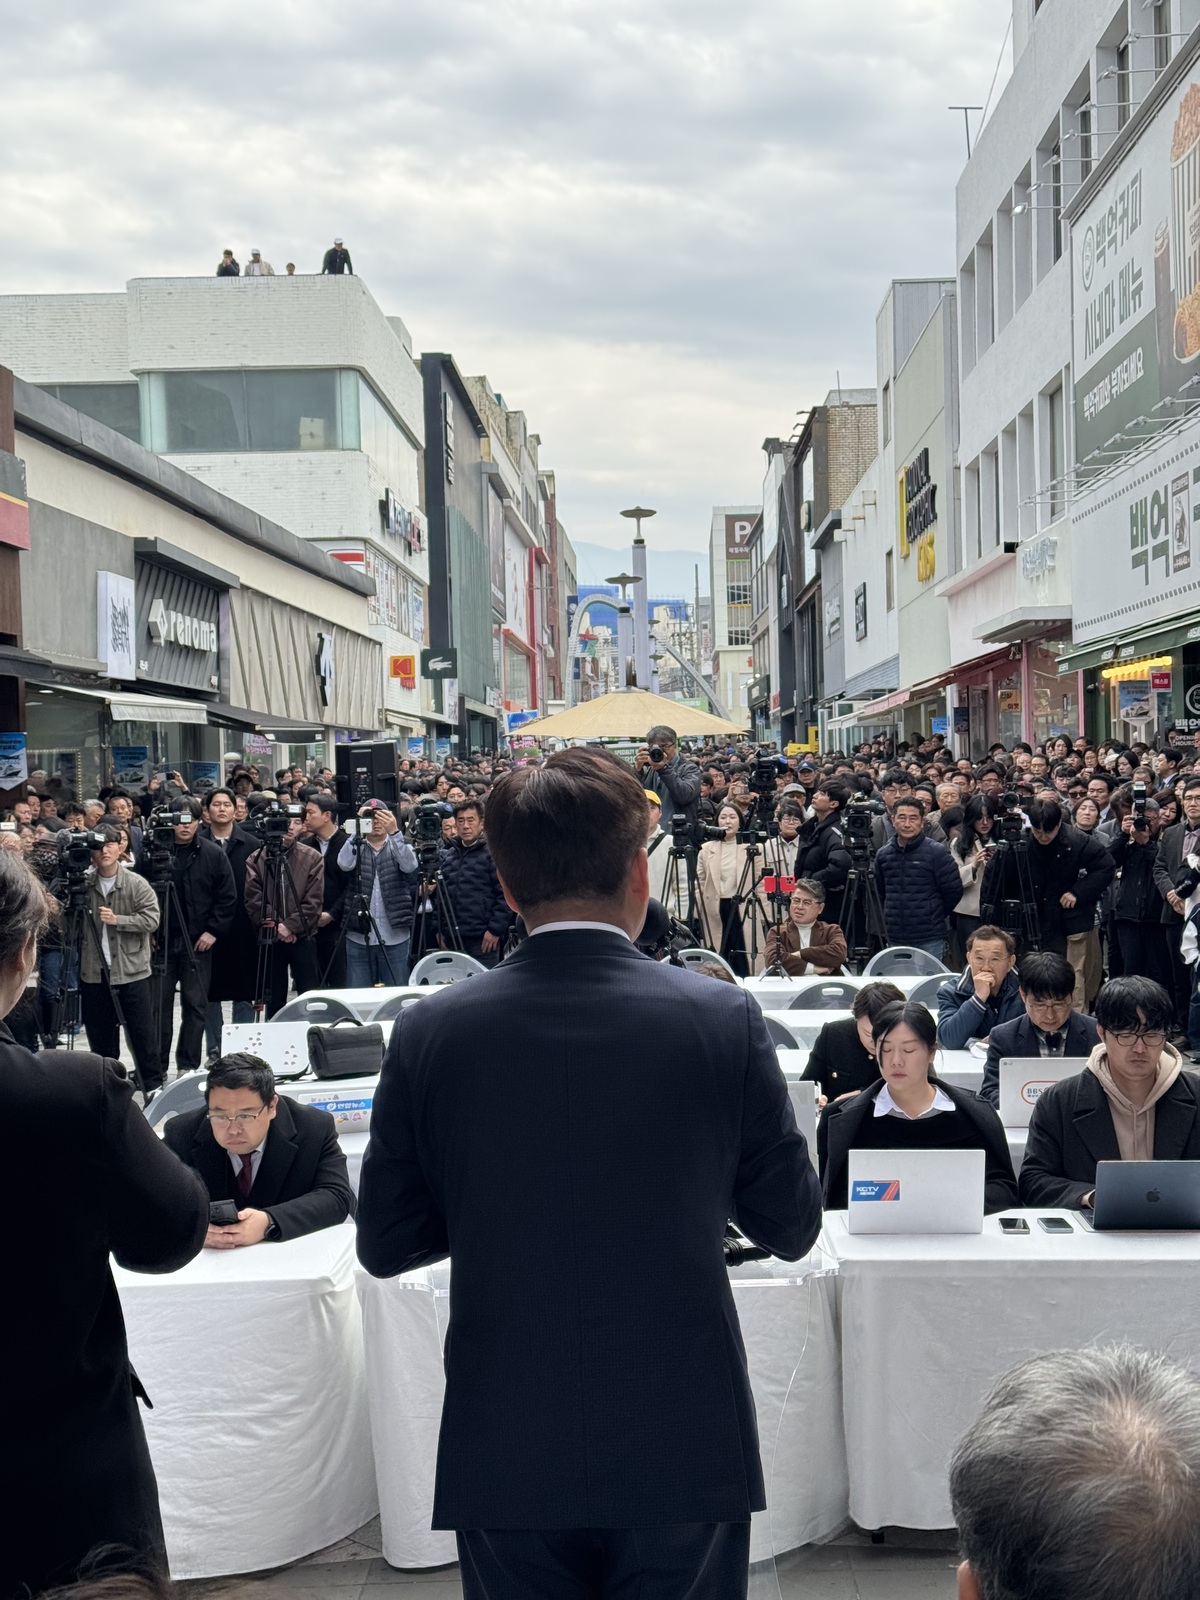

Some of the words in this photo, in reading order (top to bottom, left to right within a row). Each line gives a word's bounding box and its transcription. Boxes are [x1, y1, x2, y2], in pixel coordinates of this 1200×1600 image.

[1096, 168, 1142, 268] 백억커피
[1085, 280, 1115, 361] 시네마
[1119, 256, 1144, 325] 메뉴
[1111, 346, 1144, 399] 부자되세요
[734, 521, 752, 543] P
[168, 610, 217, 653] renoma
[337, 1101, 366, 1110] 연합뉴스
